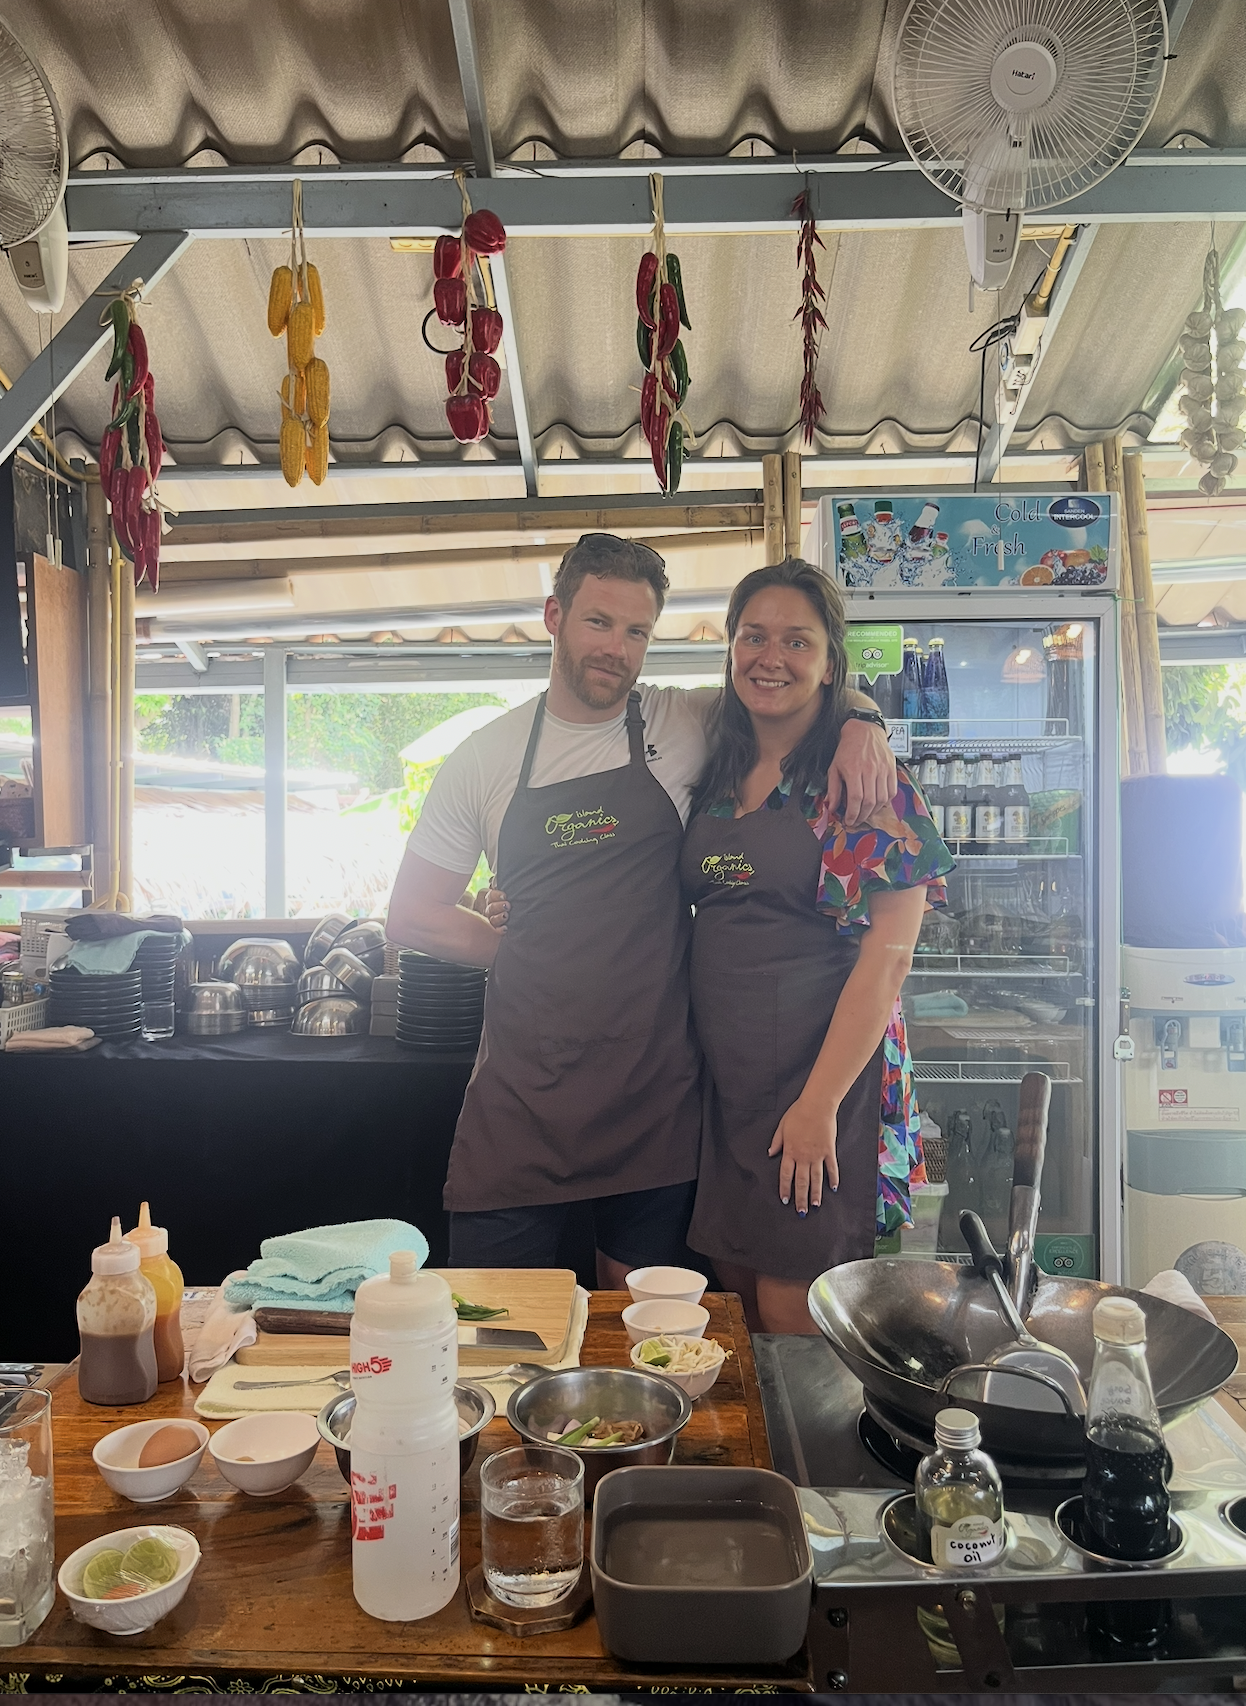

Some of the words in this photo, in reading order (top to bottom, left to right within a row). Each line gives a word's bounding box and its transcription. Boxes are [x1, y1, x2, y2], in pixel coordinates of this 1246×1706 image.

[994, 500, 1042, 522] Cold
[1053, 513, 1096, 521] INTERCOOL
[990, 524, 1000, 536] &
[544, 813, 620, 842] Organics
[701, 855, 755, 880] Organics
[963, 1551, 982, 1563] Oil
